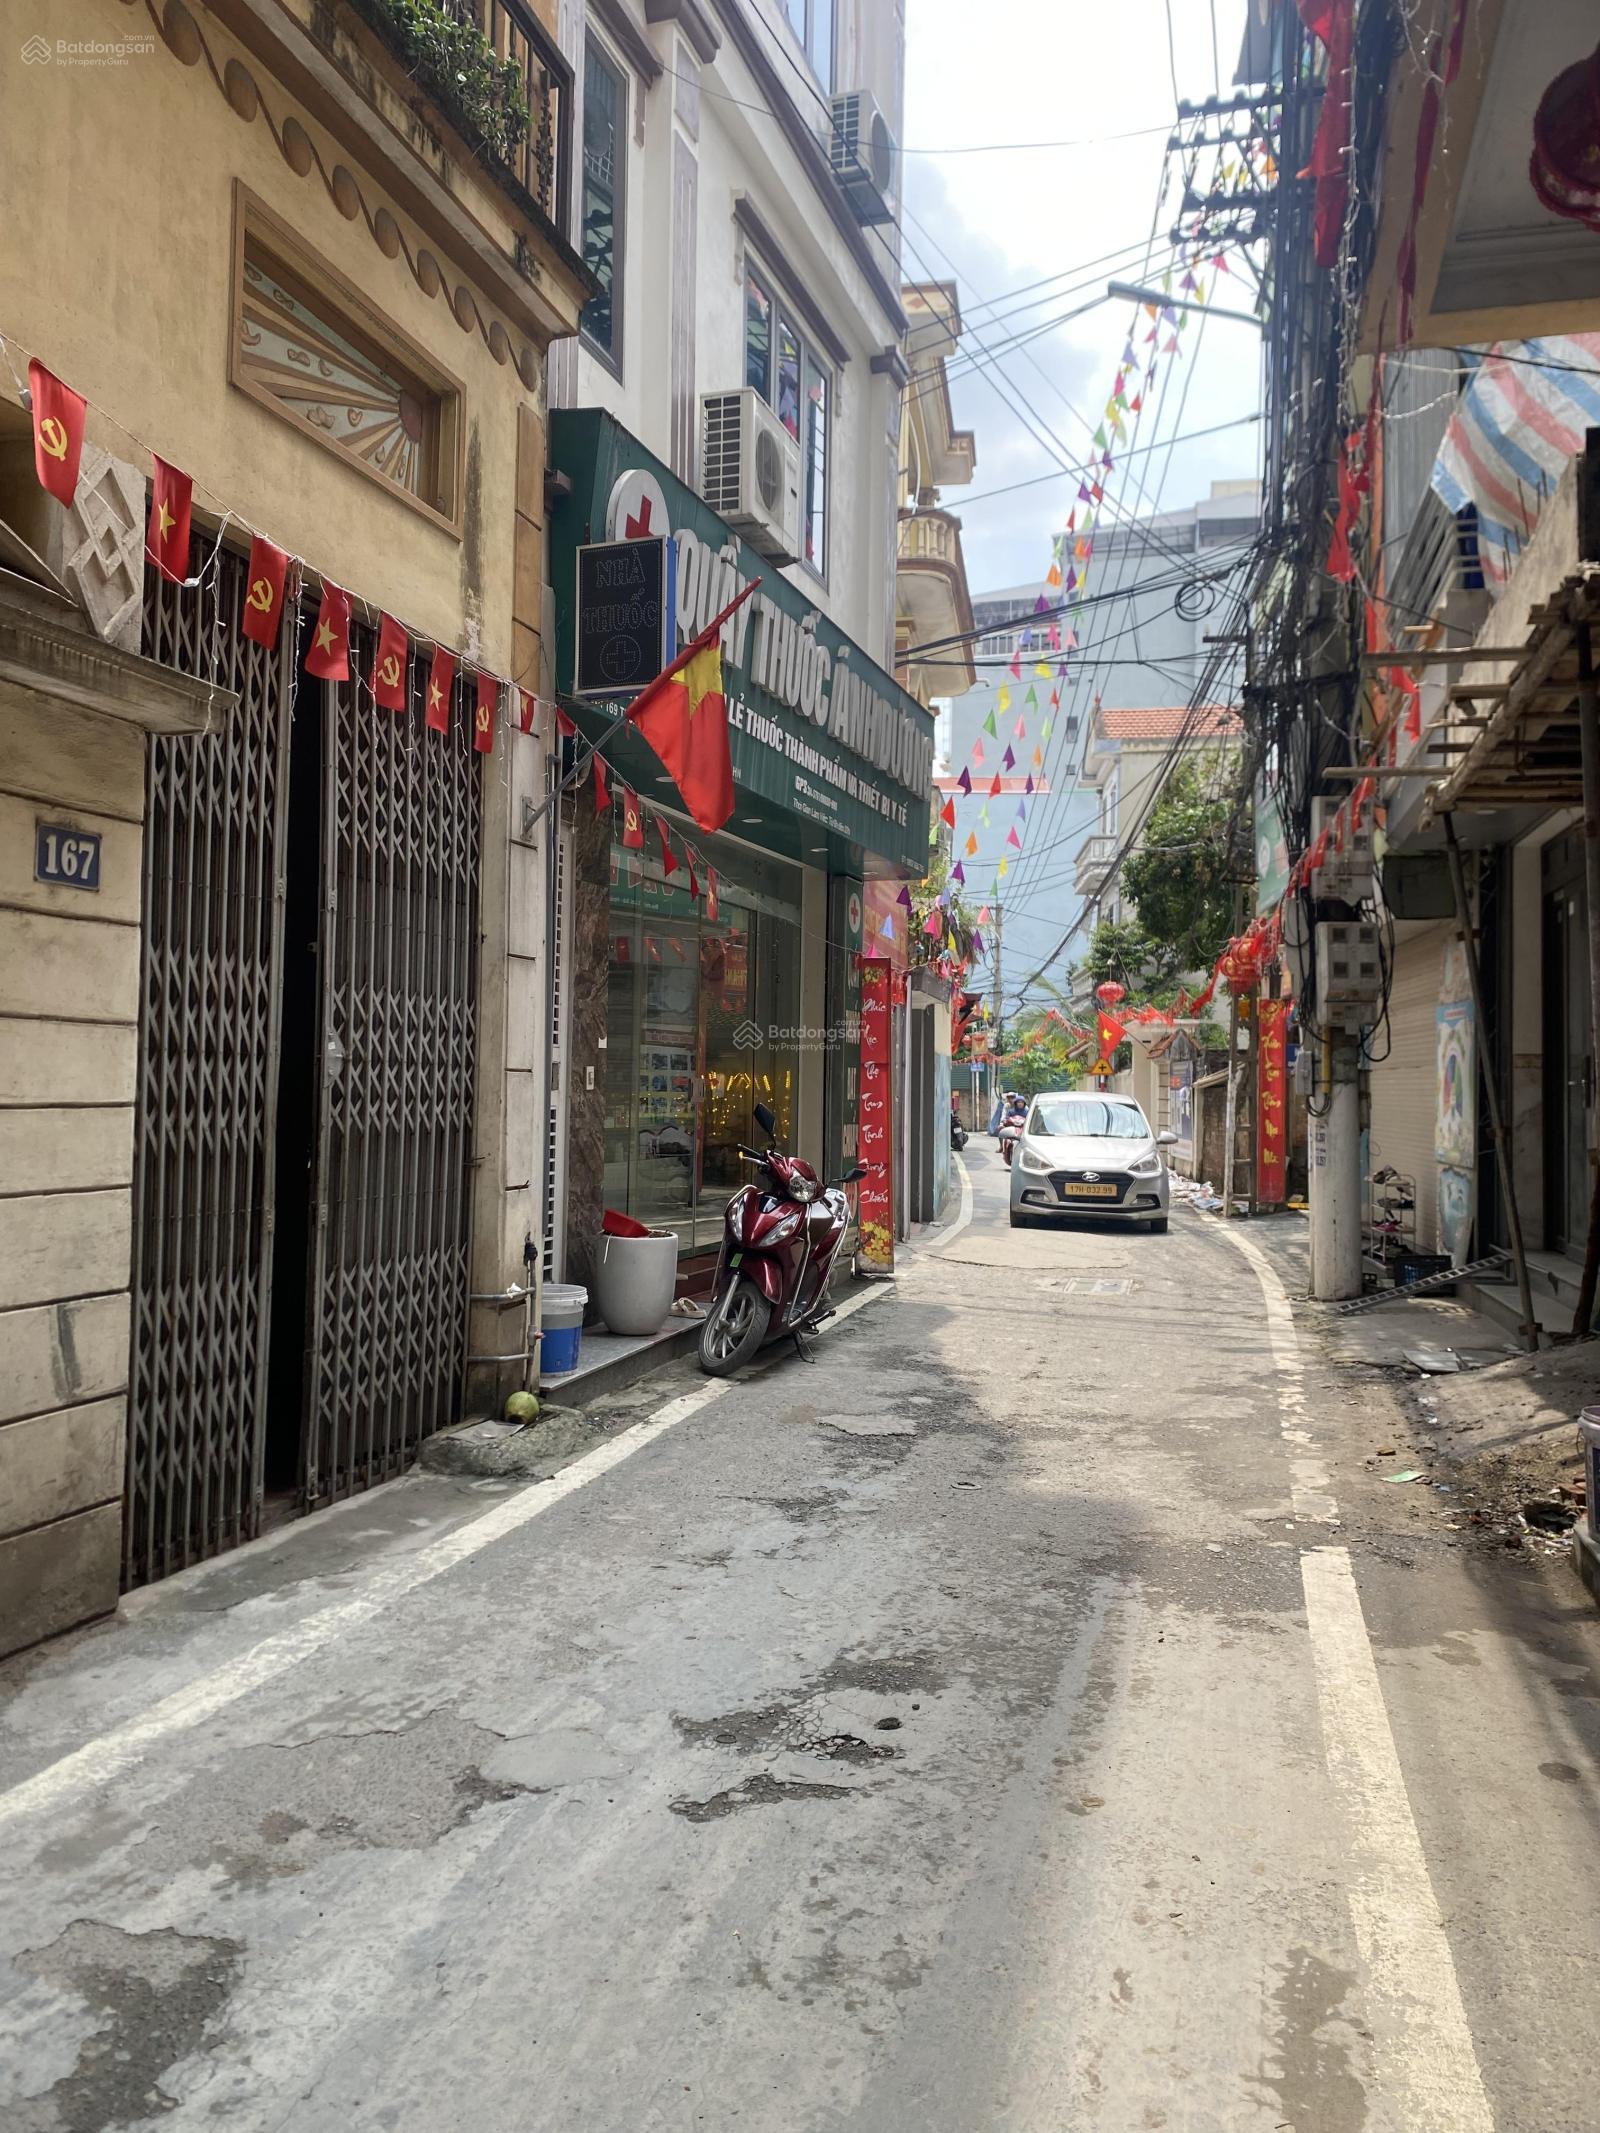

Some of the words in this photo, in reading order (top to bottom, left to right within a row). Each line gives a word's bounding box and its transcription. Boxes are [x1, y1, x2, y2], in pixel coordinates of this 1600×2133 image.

[594, 548, 646, 588] NHÀ
[583, 588, 659, 635] THUỐC
[752, 591, 831, 727] THUỐC
[728, 693, 745, 729] LẺ
[746, 707, 783, 752] THUỐC
[785, 731, 820, 774] THÀNH
[819, 755, 847, 792] PHẨM
[847, 770, 858, 799] VÀ
[858, 779, 880, 811] THIẾT
[890, 800, 898, 820] Y
[45, 834, 95, 880] 167
